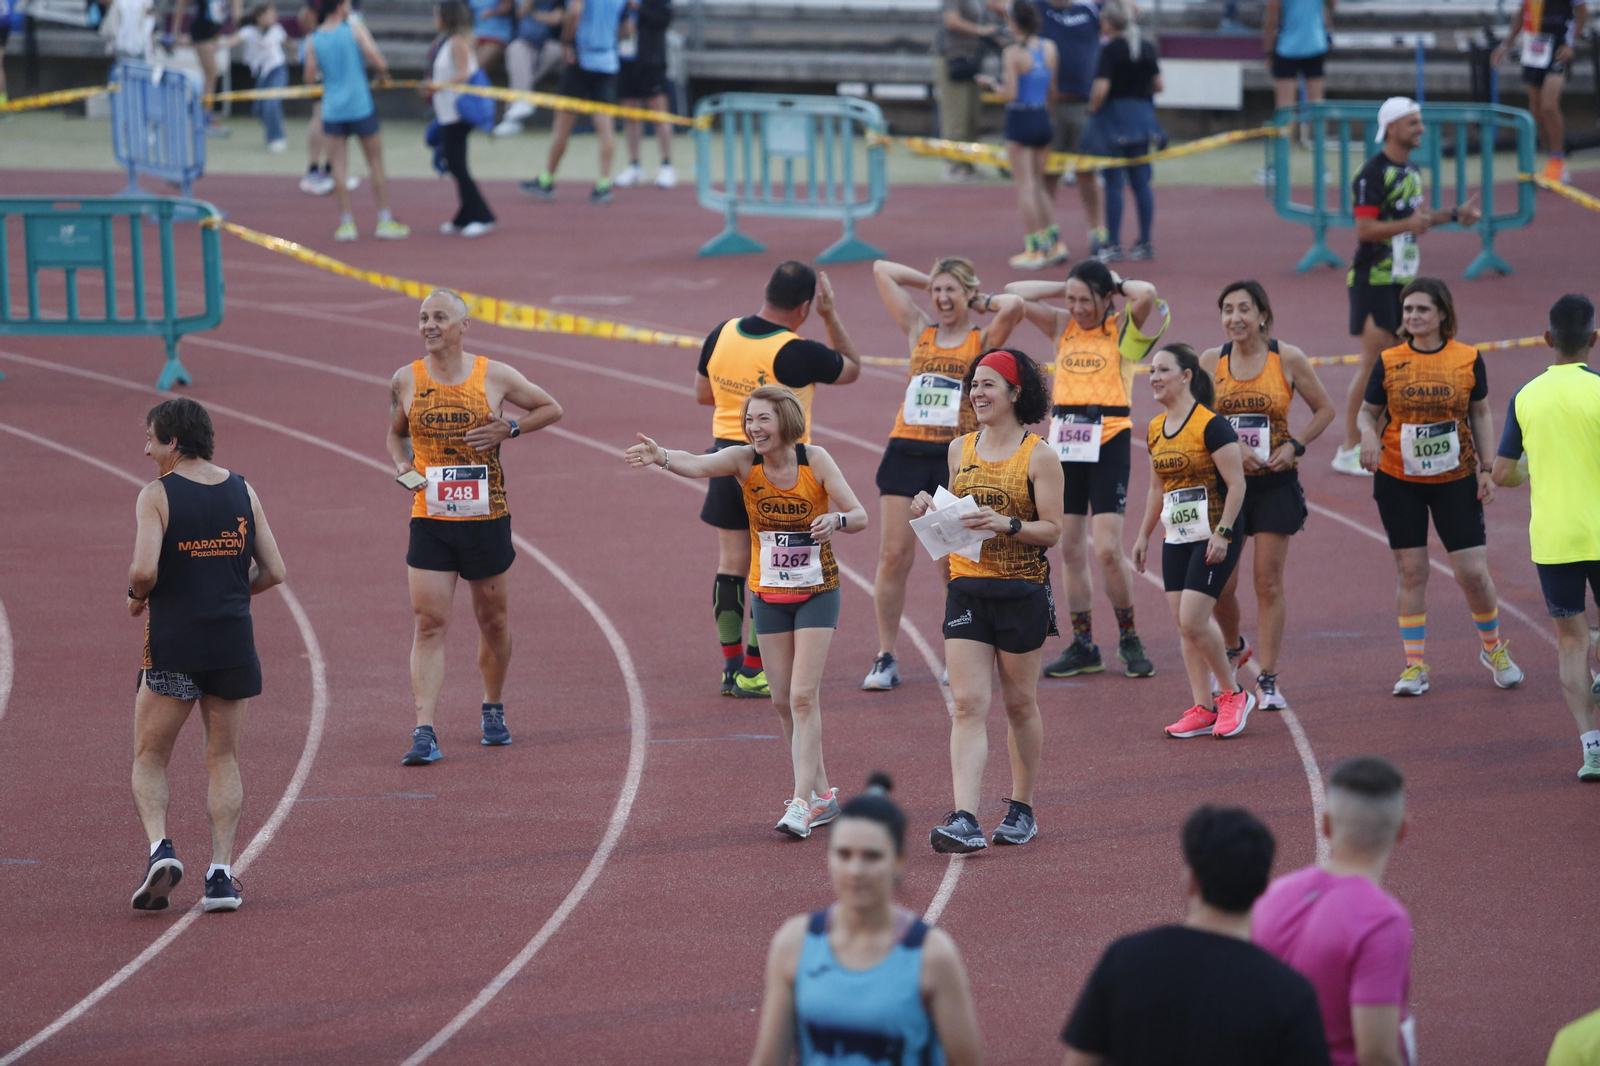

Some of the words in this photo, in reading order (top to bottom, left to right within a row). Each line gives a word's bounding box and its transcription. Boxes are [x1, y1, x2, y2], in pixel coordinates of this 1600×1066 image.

[1065, 357, 1101, 367] GALBIS
[925, 363, 965, 374] GALBIS
[923, 376, 935, 388] 21
[1406, 387, 1450, 397] GALBIS
[916, 394, 949, 407] 1071
[1223, 397, 1265, 409] GALBIS
[425, 412, 470, 424] GALBIS
[1058, 430, 1092, 443] 1546
[1241, 434, 1260, 448] 36
[1415, 440, 1451, 457] 1029
[444, 469, 457, 481] 21
[444, 486, 473, 500] 248
[962, 493, 1004, 506] ALBIS
[761, 503, 808, 514] GALBIS
[1171, 508, 1199, 525] 1054
[178, 539, 242, 551] MARATON
[777, 535, 789, 547] 21
[191, 548, 238, 557] Pozoblanco
[772, 553, 809, 568] 1262
[779, 571, 790, 580] H
